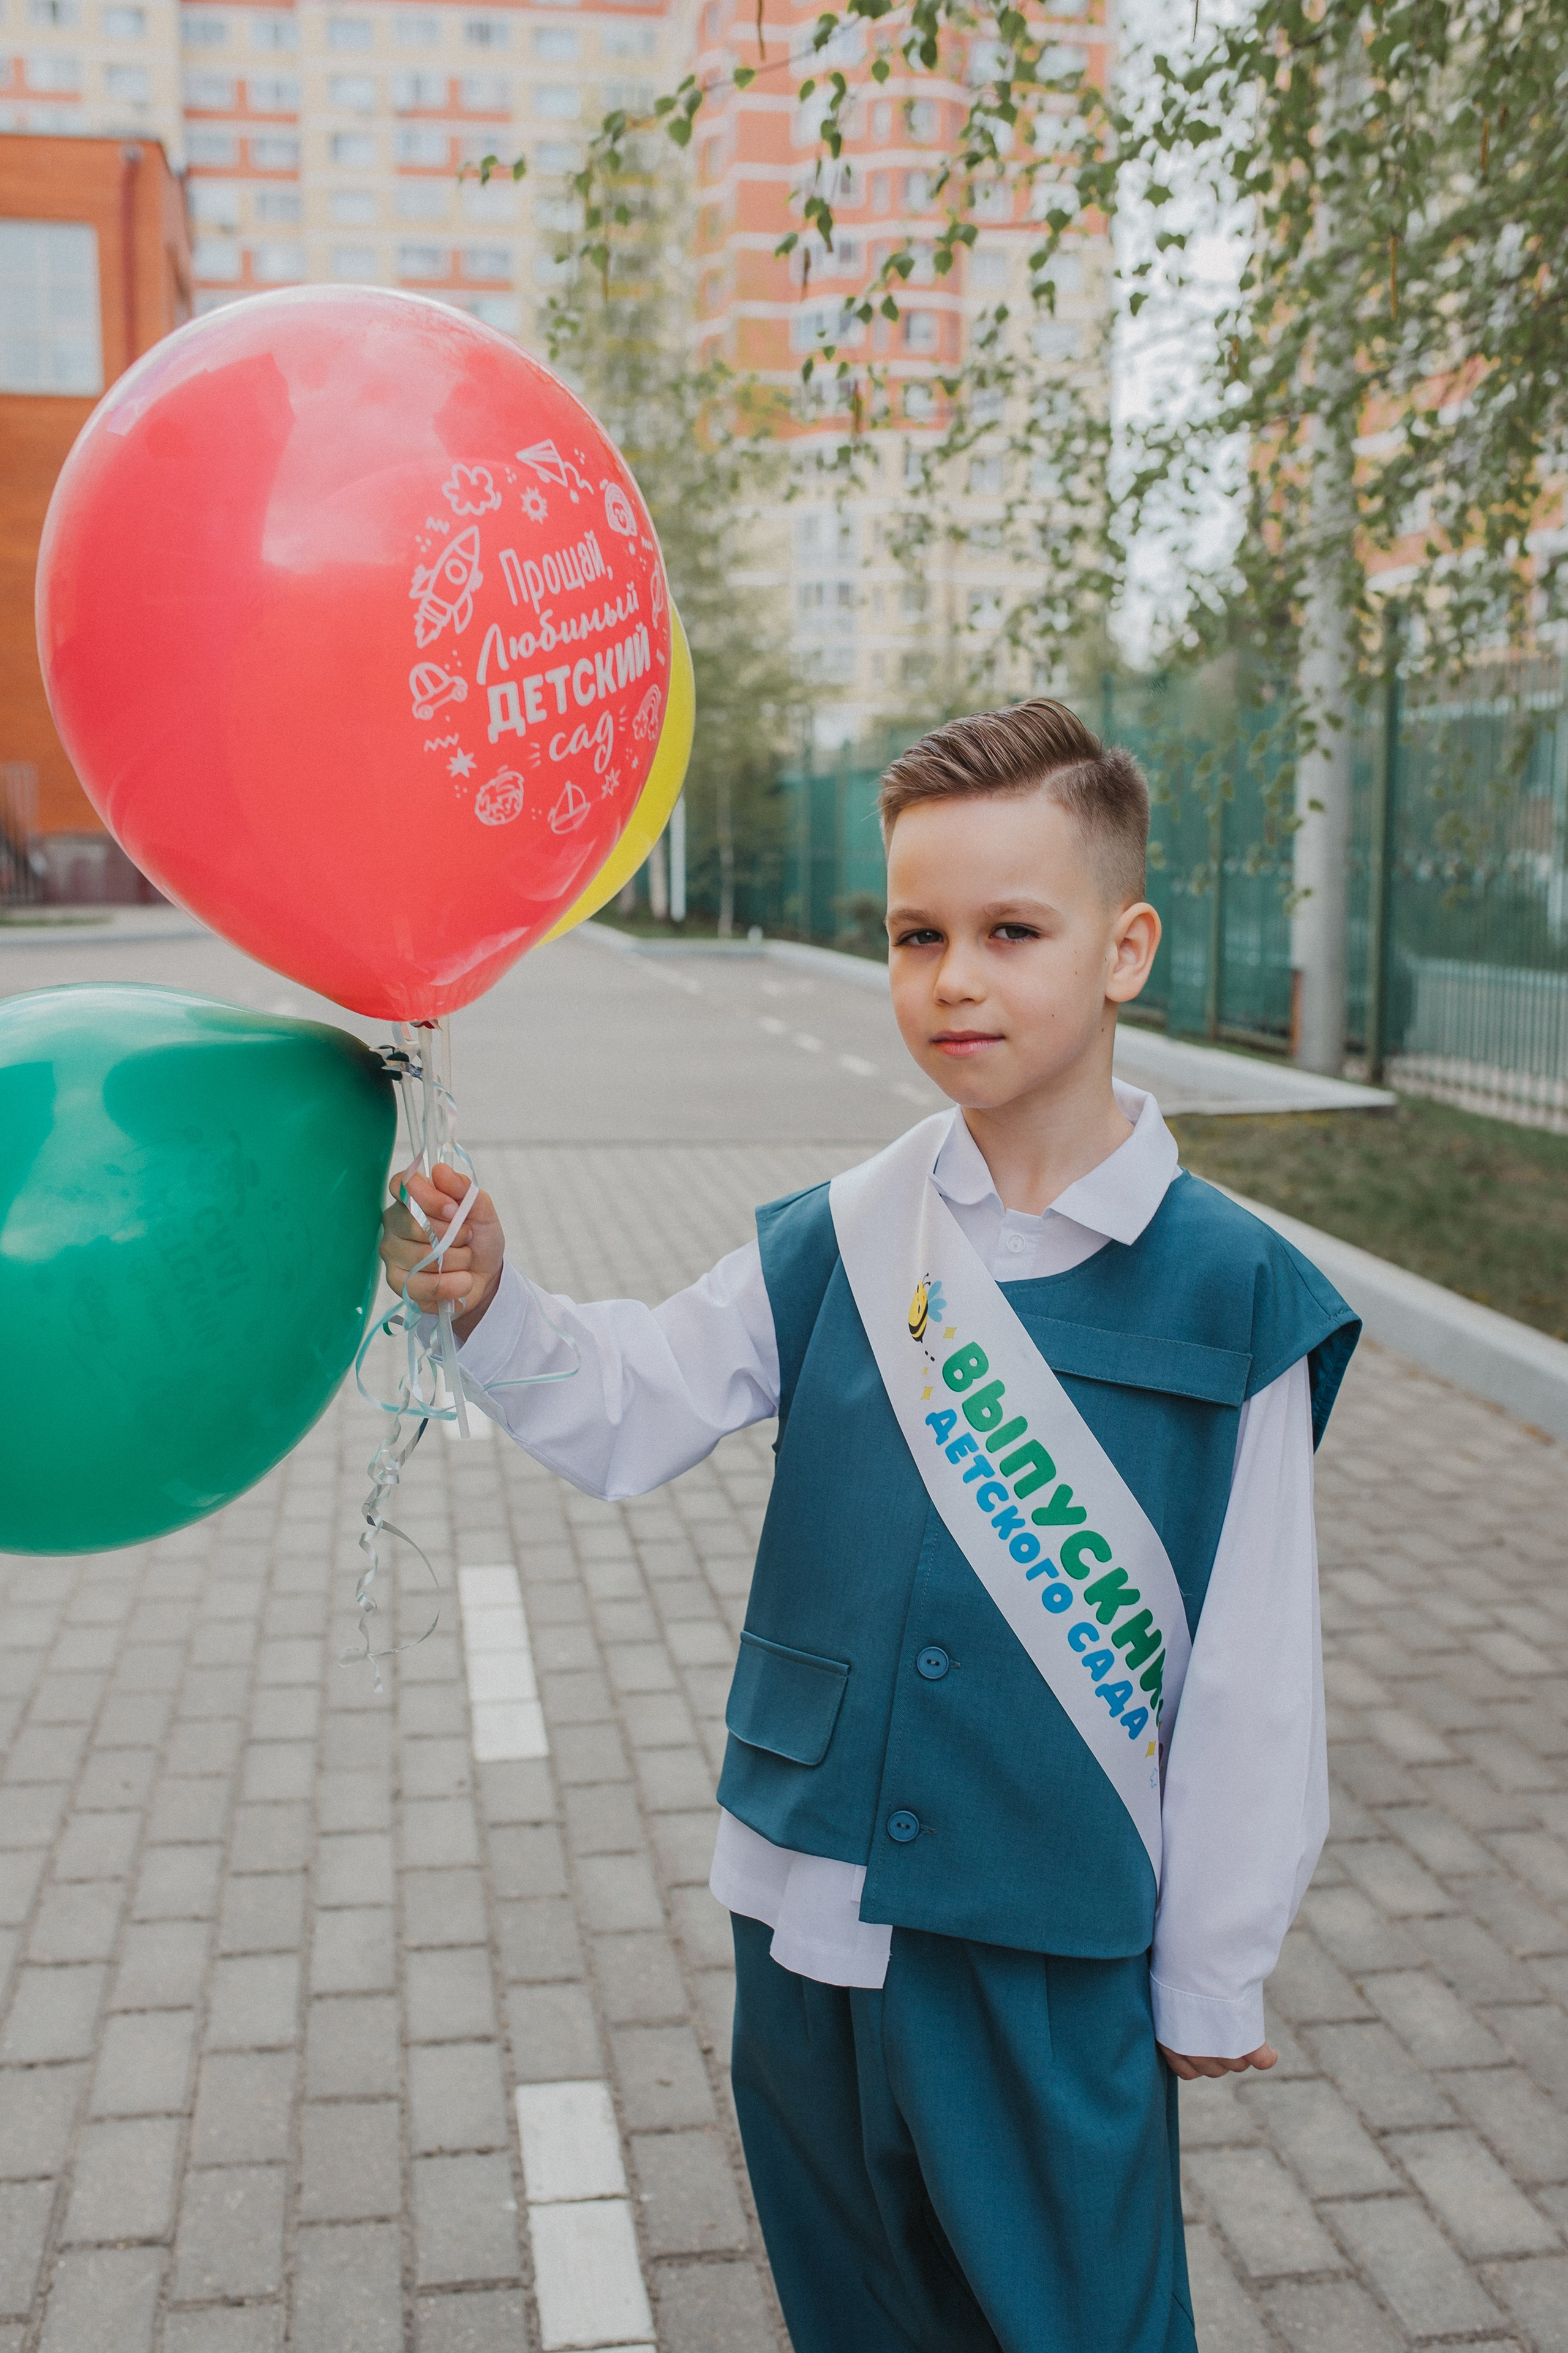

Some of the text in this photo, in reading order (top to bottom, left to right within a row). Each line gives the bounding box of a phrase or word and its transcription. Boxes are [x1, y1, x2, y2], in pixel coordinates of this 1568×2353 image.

[498, 529, 613, 615] Прощай,
[476, 581, 639, 686] Любимый
[486, 622, 651, 744] ДЕТСКИЙ
[549, 711, 614, 774] сад
[925, 1408, 1149, 1740] ДЕТСКОГО САДА
[942, 1342, 1166, 1728] ВЫПУСКНИ
